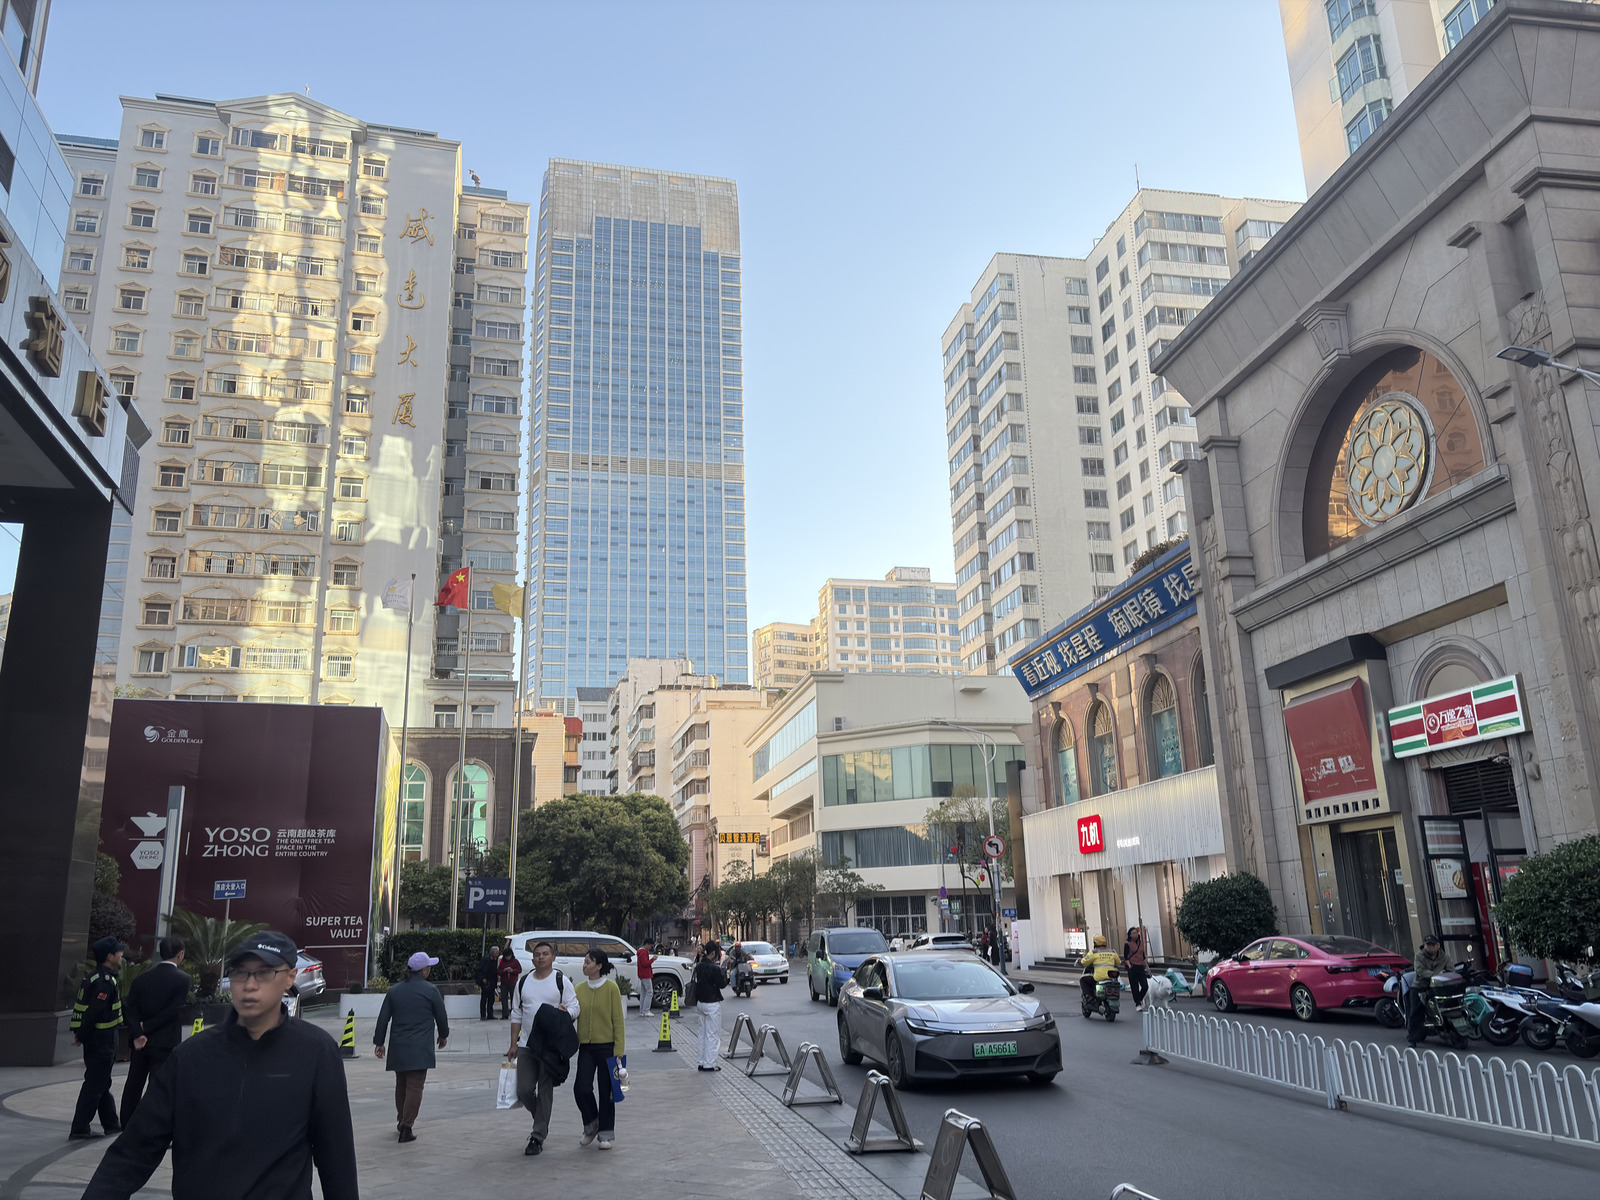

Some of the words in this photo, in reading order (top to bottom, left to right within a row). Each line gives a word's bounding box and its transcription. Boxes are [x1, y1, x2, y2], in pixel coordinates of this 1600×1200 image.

[1020, 648, 1062, 687] 看近视
[1057, 623, 1105, 668] 找星程
[1107, 586, 1168, 639] 摘眼镜
[204, 827, 271, 843] YOSO
[277, 829, 337, 838] 云南超级茶库
[1080, 821, 1100, 848] 九机
[201, 844, 269, 858] ZHONG
[468, 887, 485, 909] P
[305, 916, 341, 927] SUPER
[343, 915, 363, 926] TEA
[329, 928, 363, 939] VAULT
[261, 944, 281, 953] Columbia
